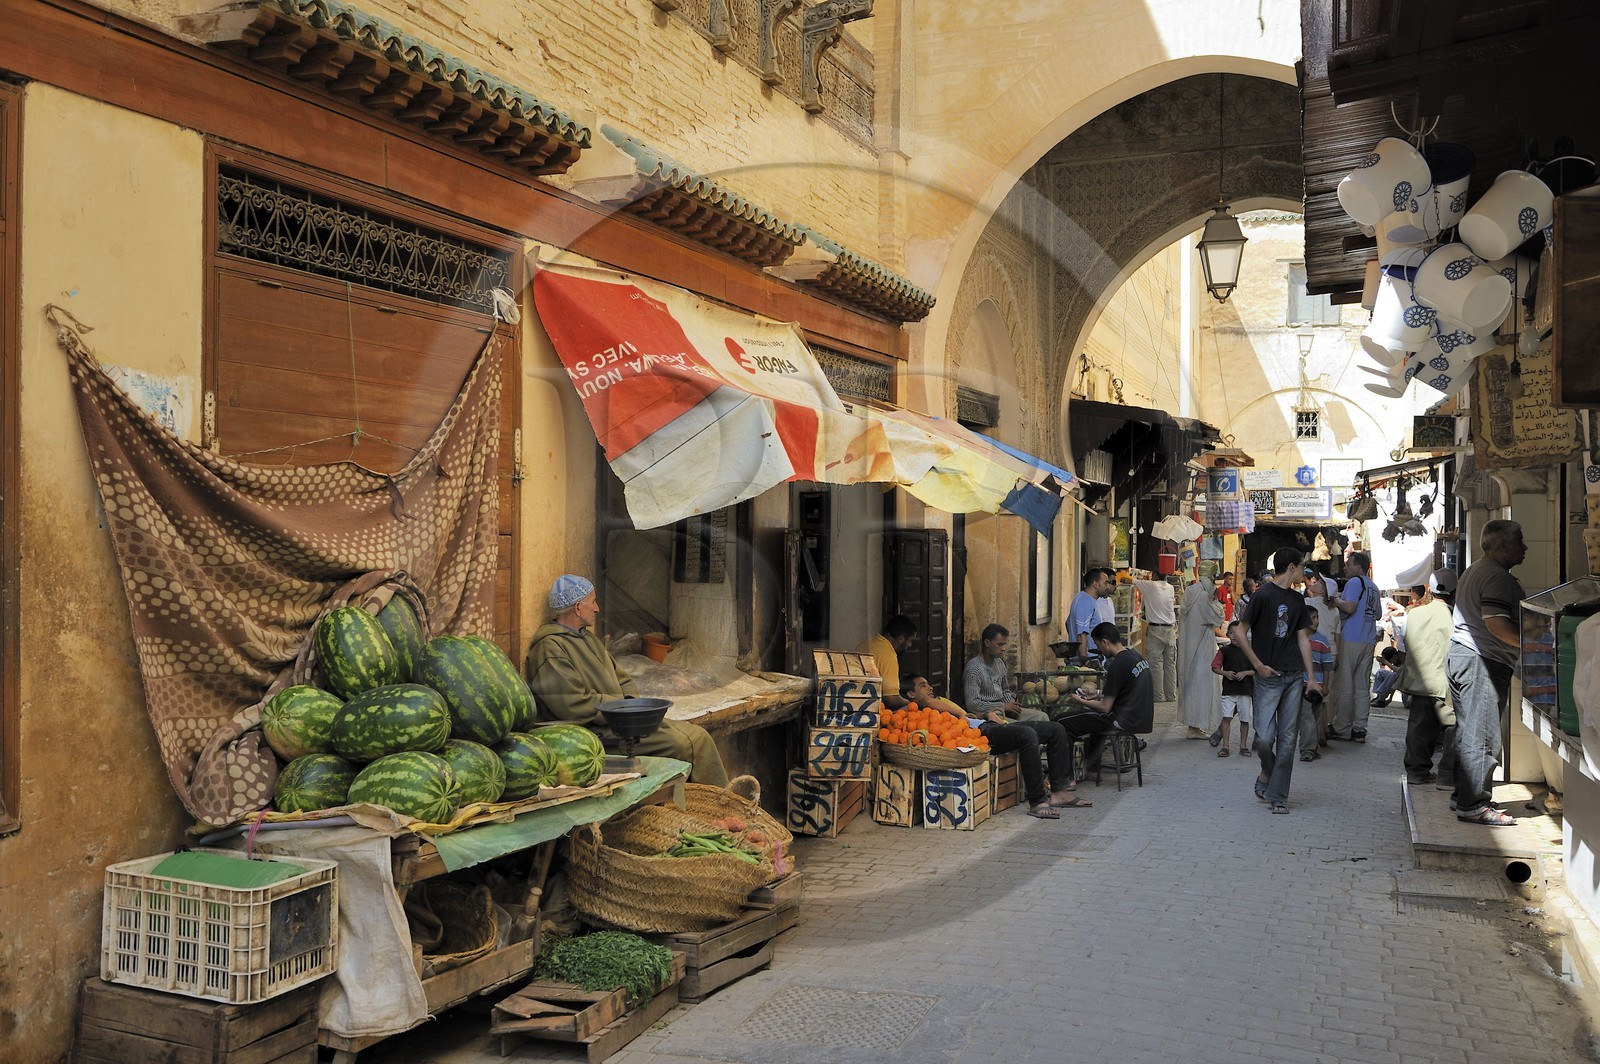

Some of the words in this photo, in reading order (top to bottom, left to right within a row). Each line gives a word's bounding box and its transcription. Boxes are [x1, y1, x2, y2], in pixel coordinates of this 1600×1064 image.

[752, 355, 799, 374] FAGOR
[811, 731, 870, 777] 290
[925, 769, 968, 826] 290
